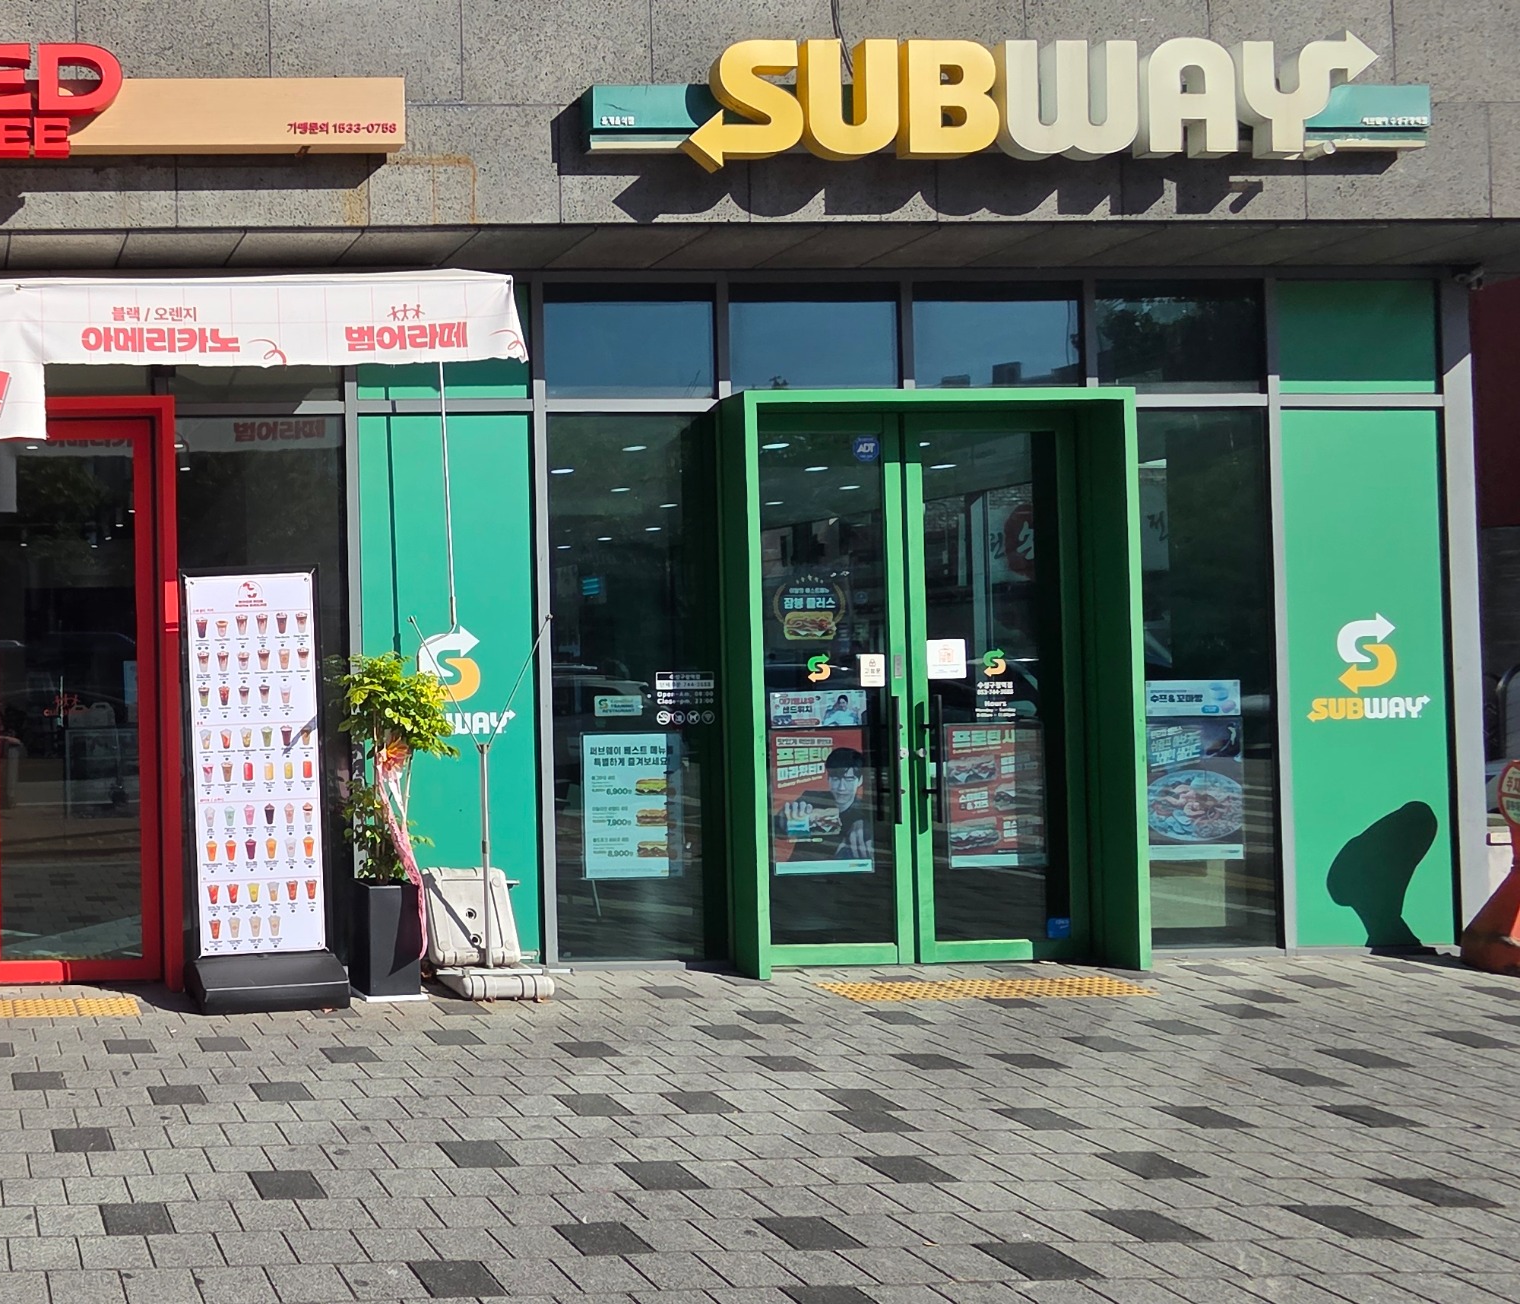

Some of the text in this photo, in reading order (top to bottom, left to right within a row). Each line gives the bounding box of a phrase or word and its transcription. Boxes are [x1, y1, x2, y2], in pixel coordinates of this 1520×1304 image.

[680, 30, 1379, 174] SUBWAY
[111, 306, 140, 322] 블랙
[154, 306, 197, 322] 오렌지
[81, 326, 240, 353] 아메리카노
[345, 321, 468, 352] 범어라떼
[857, 443, 876, 453] ADT
[1307, 694, 1430, 722] SUBWAY
